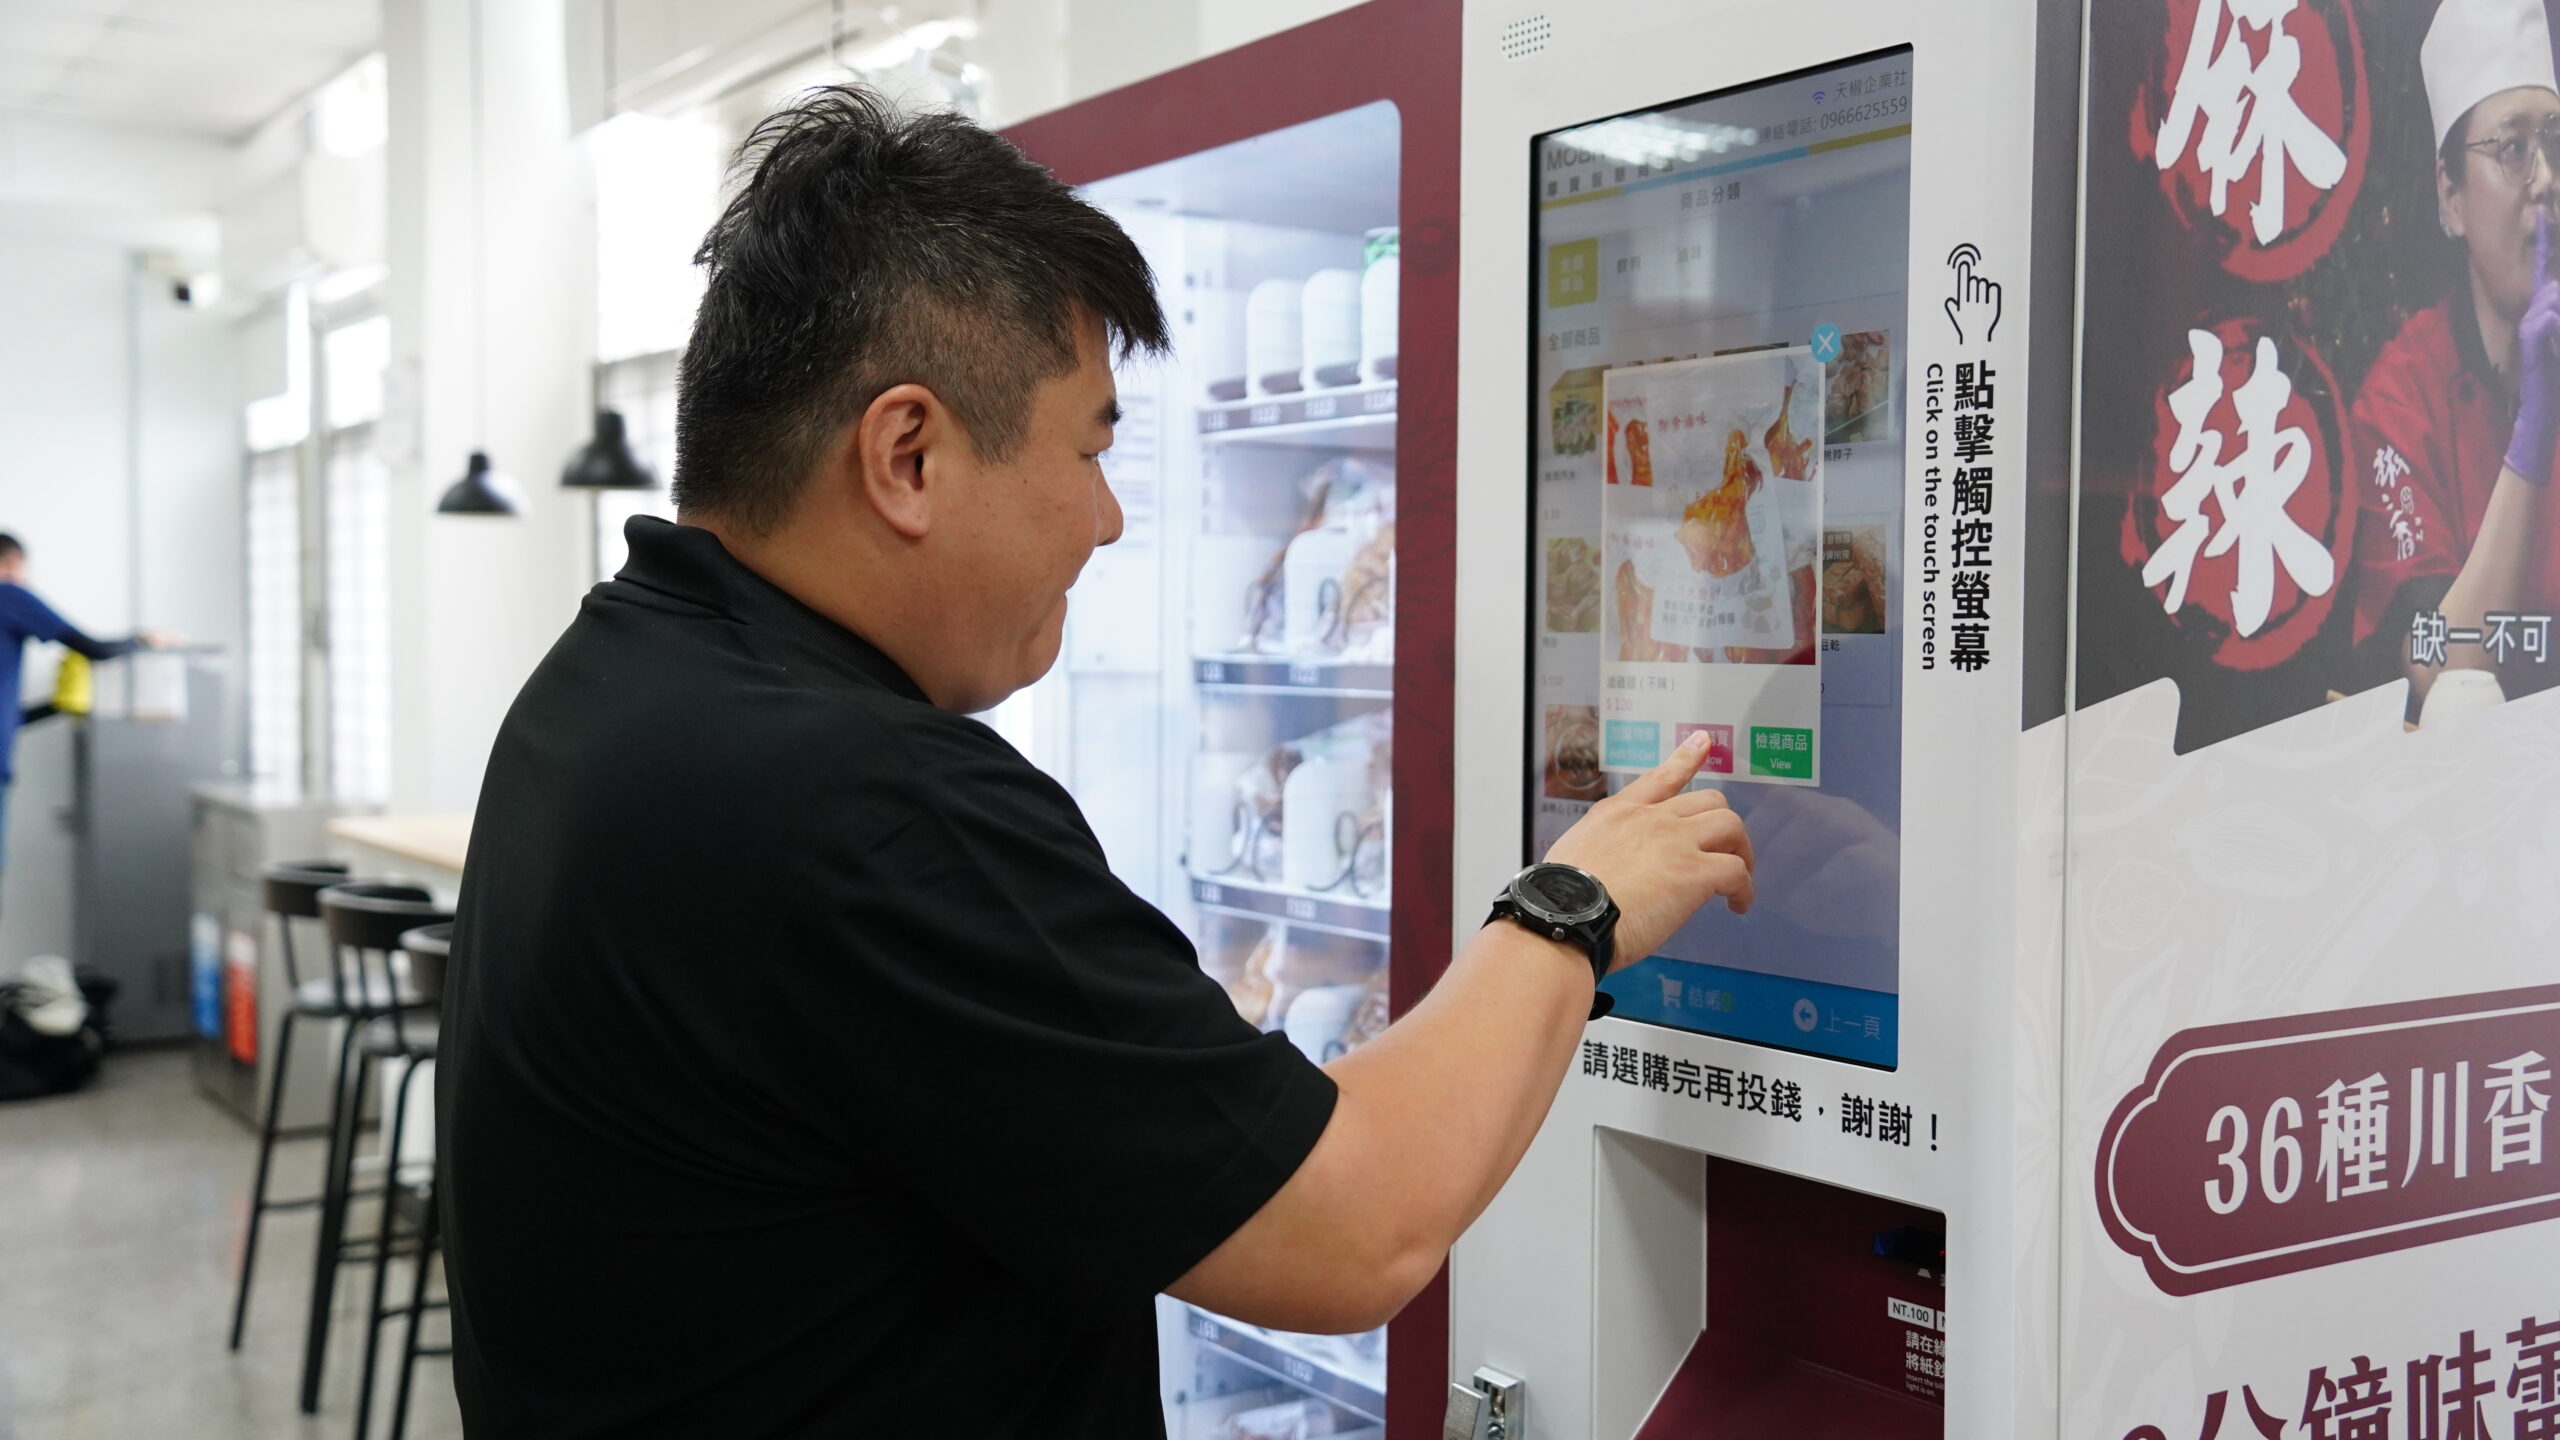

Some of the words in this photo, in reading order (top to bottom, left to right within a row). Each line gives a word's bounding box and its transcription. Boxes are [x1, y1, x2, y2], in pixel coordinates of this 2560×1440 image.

[1821, 96, 1908, 131] 0966625559
[1680, 182, 1741, 210] 商品分類
[1548, 326, 1600, 351] 全部商品
[1926, 363, 1943, 422] Click
[1926, 429, 1940, 460] on
[1924, 463, 1942, 508] the
[1949, 359, 1996, 673] 點擊觸控螢幕
[1923, 513, 1941, 584] touch
[1922, 589, 1936, 671] screen
[2411, 611, 2551, 663] 缺一不可
[1755, 732, 1808, 752] 檢視商品
[1769, 757, 1792, 771] View
[1824, 1009, 1881, 1041] 上一頁
[2204, 1050, 2553, 1215] 36種川香
[1892, 1301, 1930, 1323] NT.100
